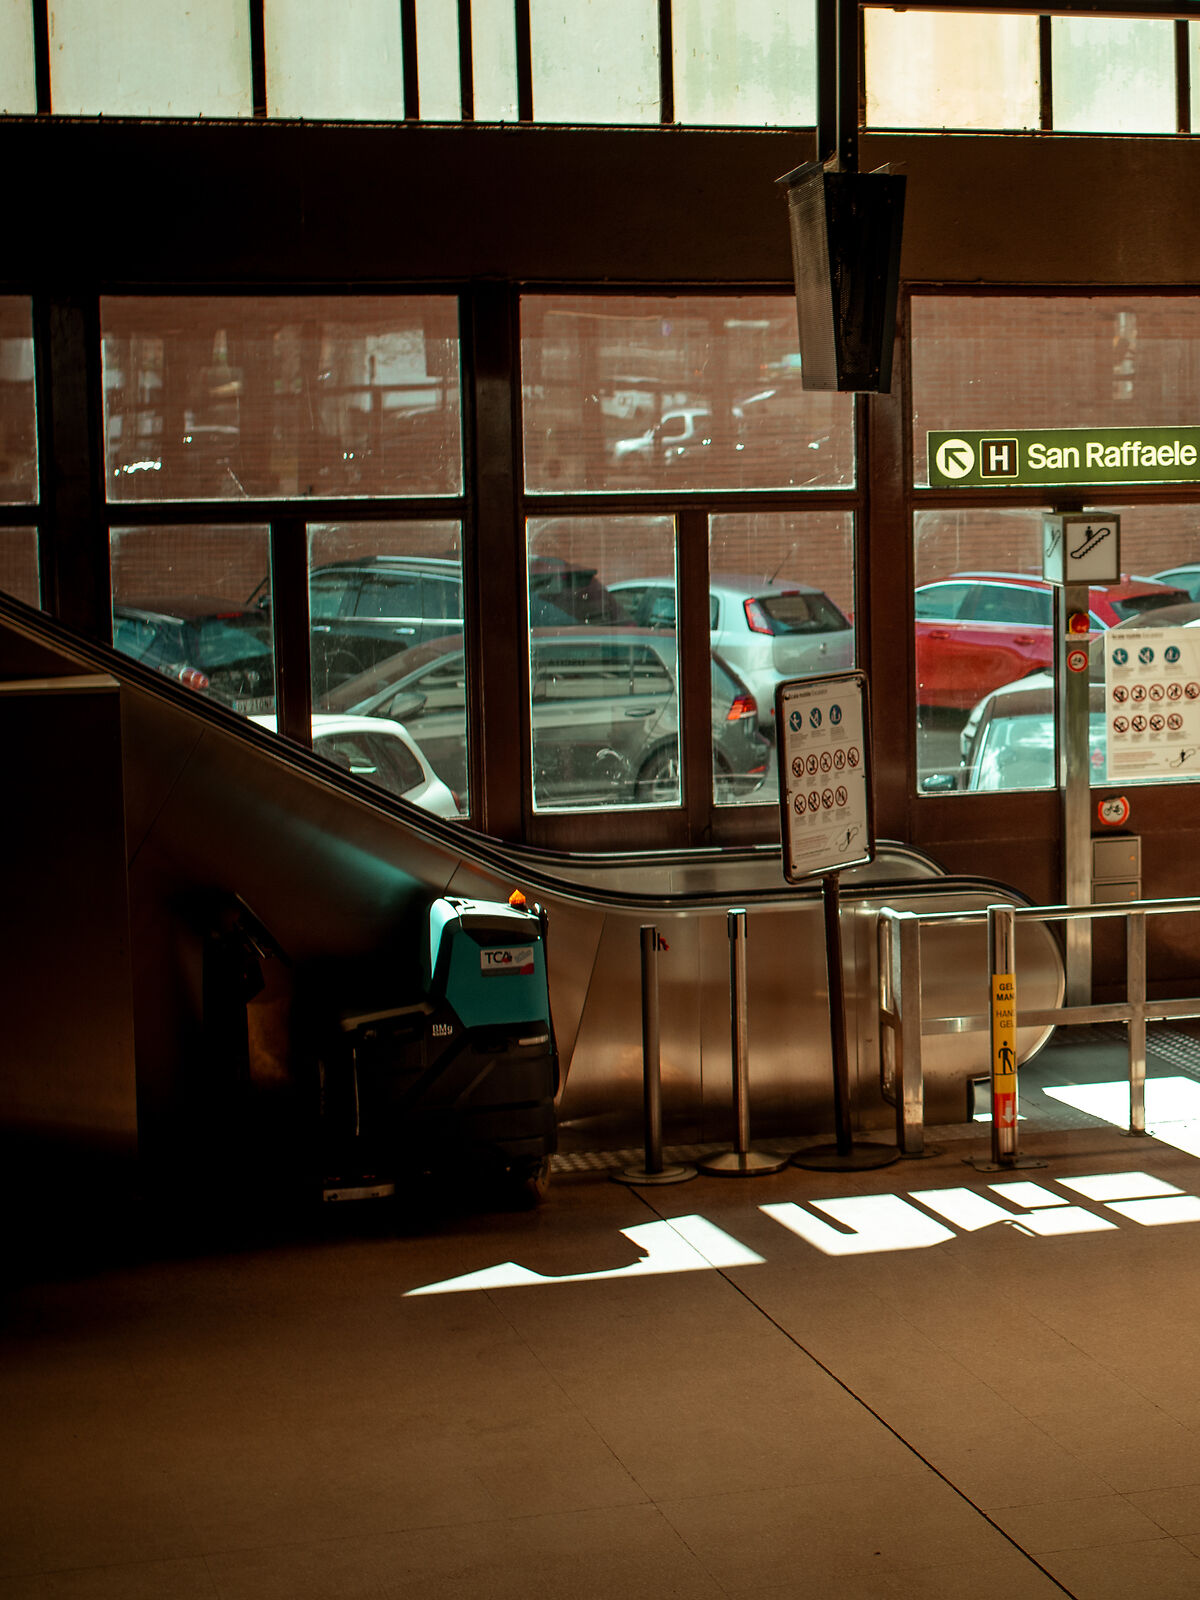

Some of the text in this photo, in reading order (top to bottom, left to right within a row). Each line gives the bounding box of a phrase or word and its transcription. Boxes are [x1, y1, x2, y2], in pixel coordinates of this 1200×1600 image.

[989, 440, 1198, 471] H San Raffaele
[484, 950, 512, 964] TCA
